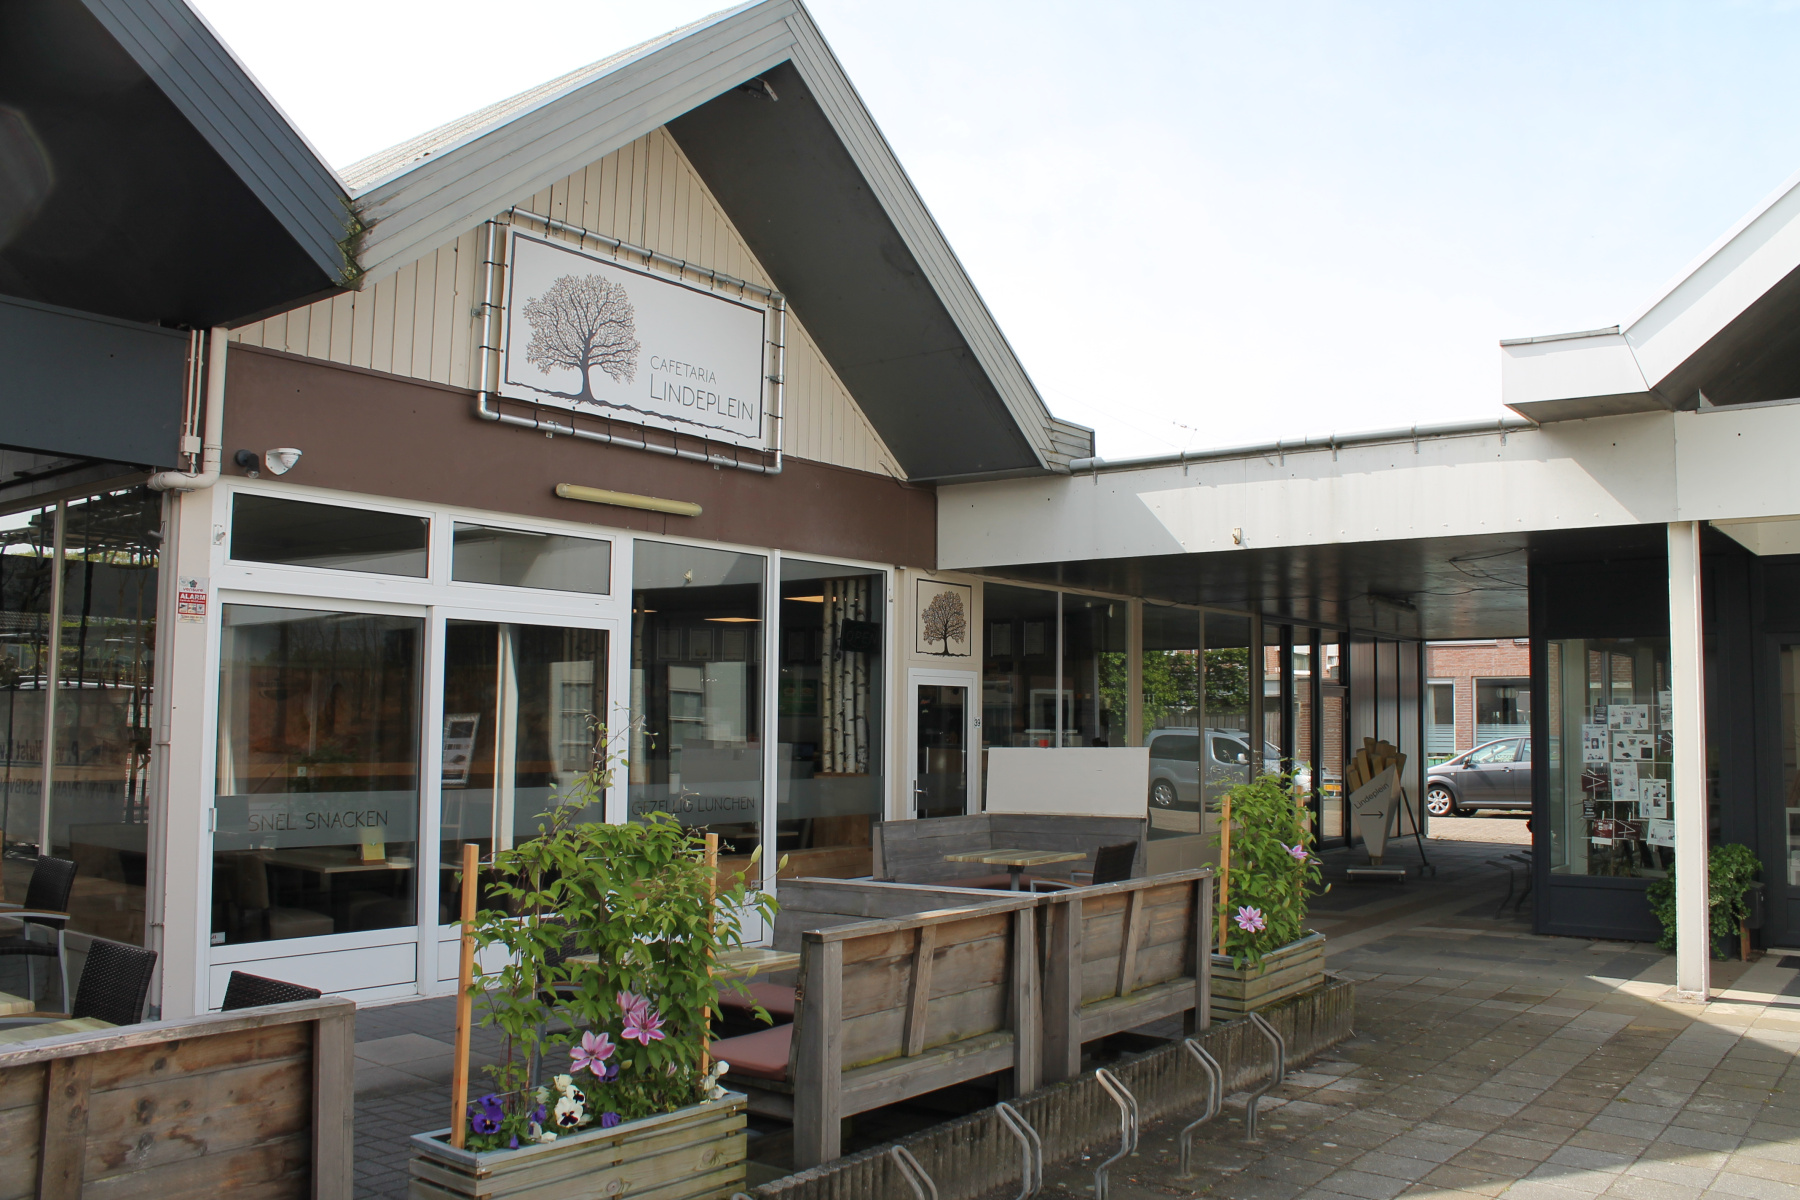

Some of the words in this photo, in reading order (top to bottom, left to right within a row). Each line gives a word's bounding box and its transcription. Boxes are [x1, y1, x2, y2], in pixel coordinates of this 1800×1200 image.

[650, 355, 717, 385] CAFETARIA
[650, 373, 754, 422] LINDEPLEIN
[846, 630, 878, 644] OPEN
[974, 718, 981, 727] 39
[697, 796, 755, 812] LUNCHEN
[1353, 783, 1390, 809] Lindeplein
[249, 813, 297, 831] SNEL
[305, 810, 388, 829] SNACKEN
